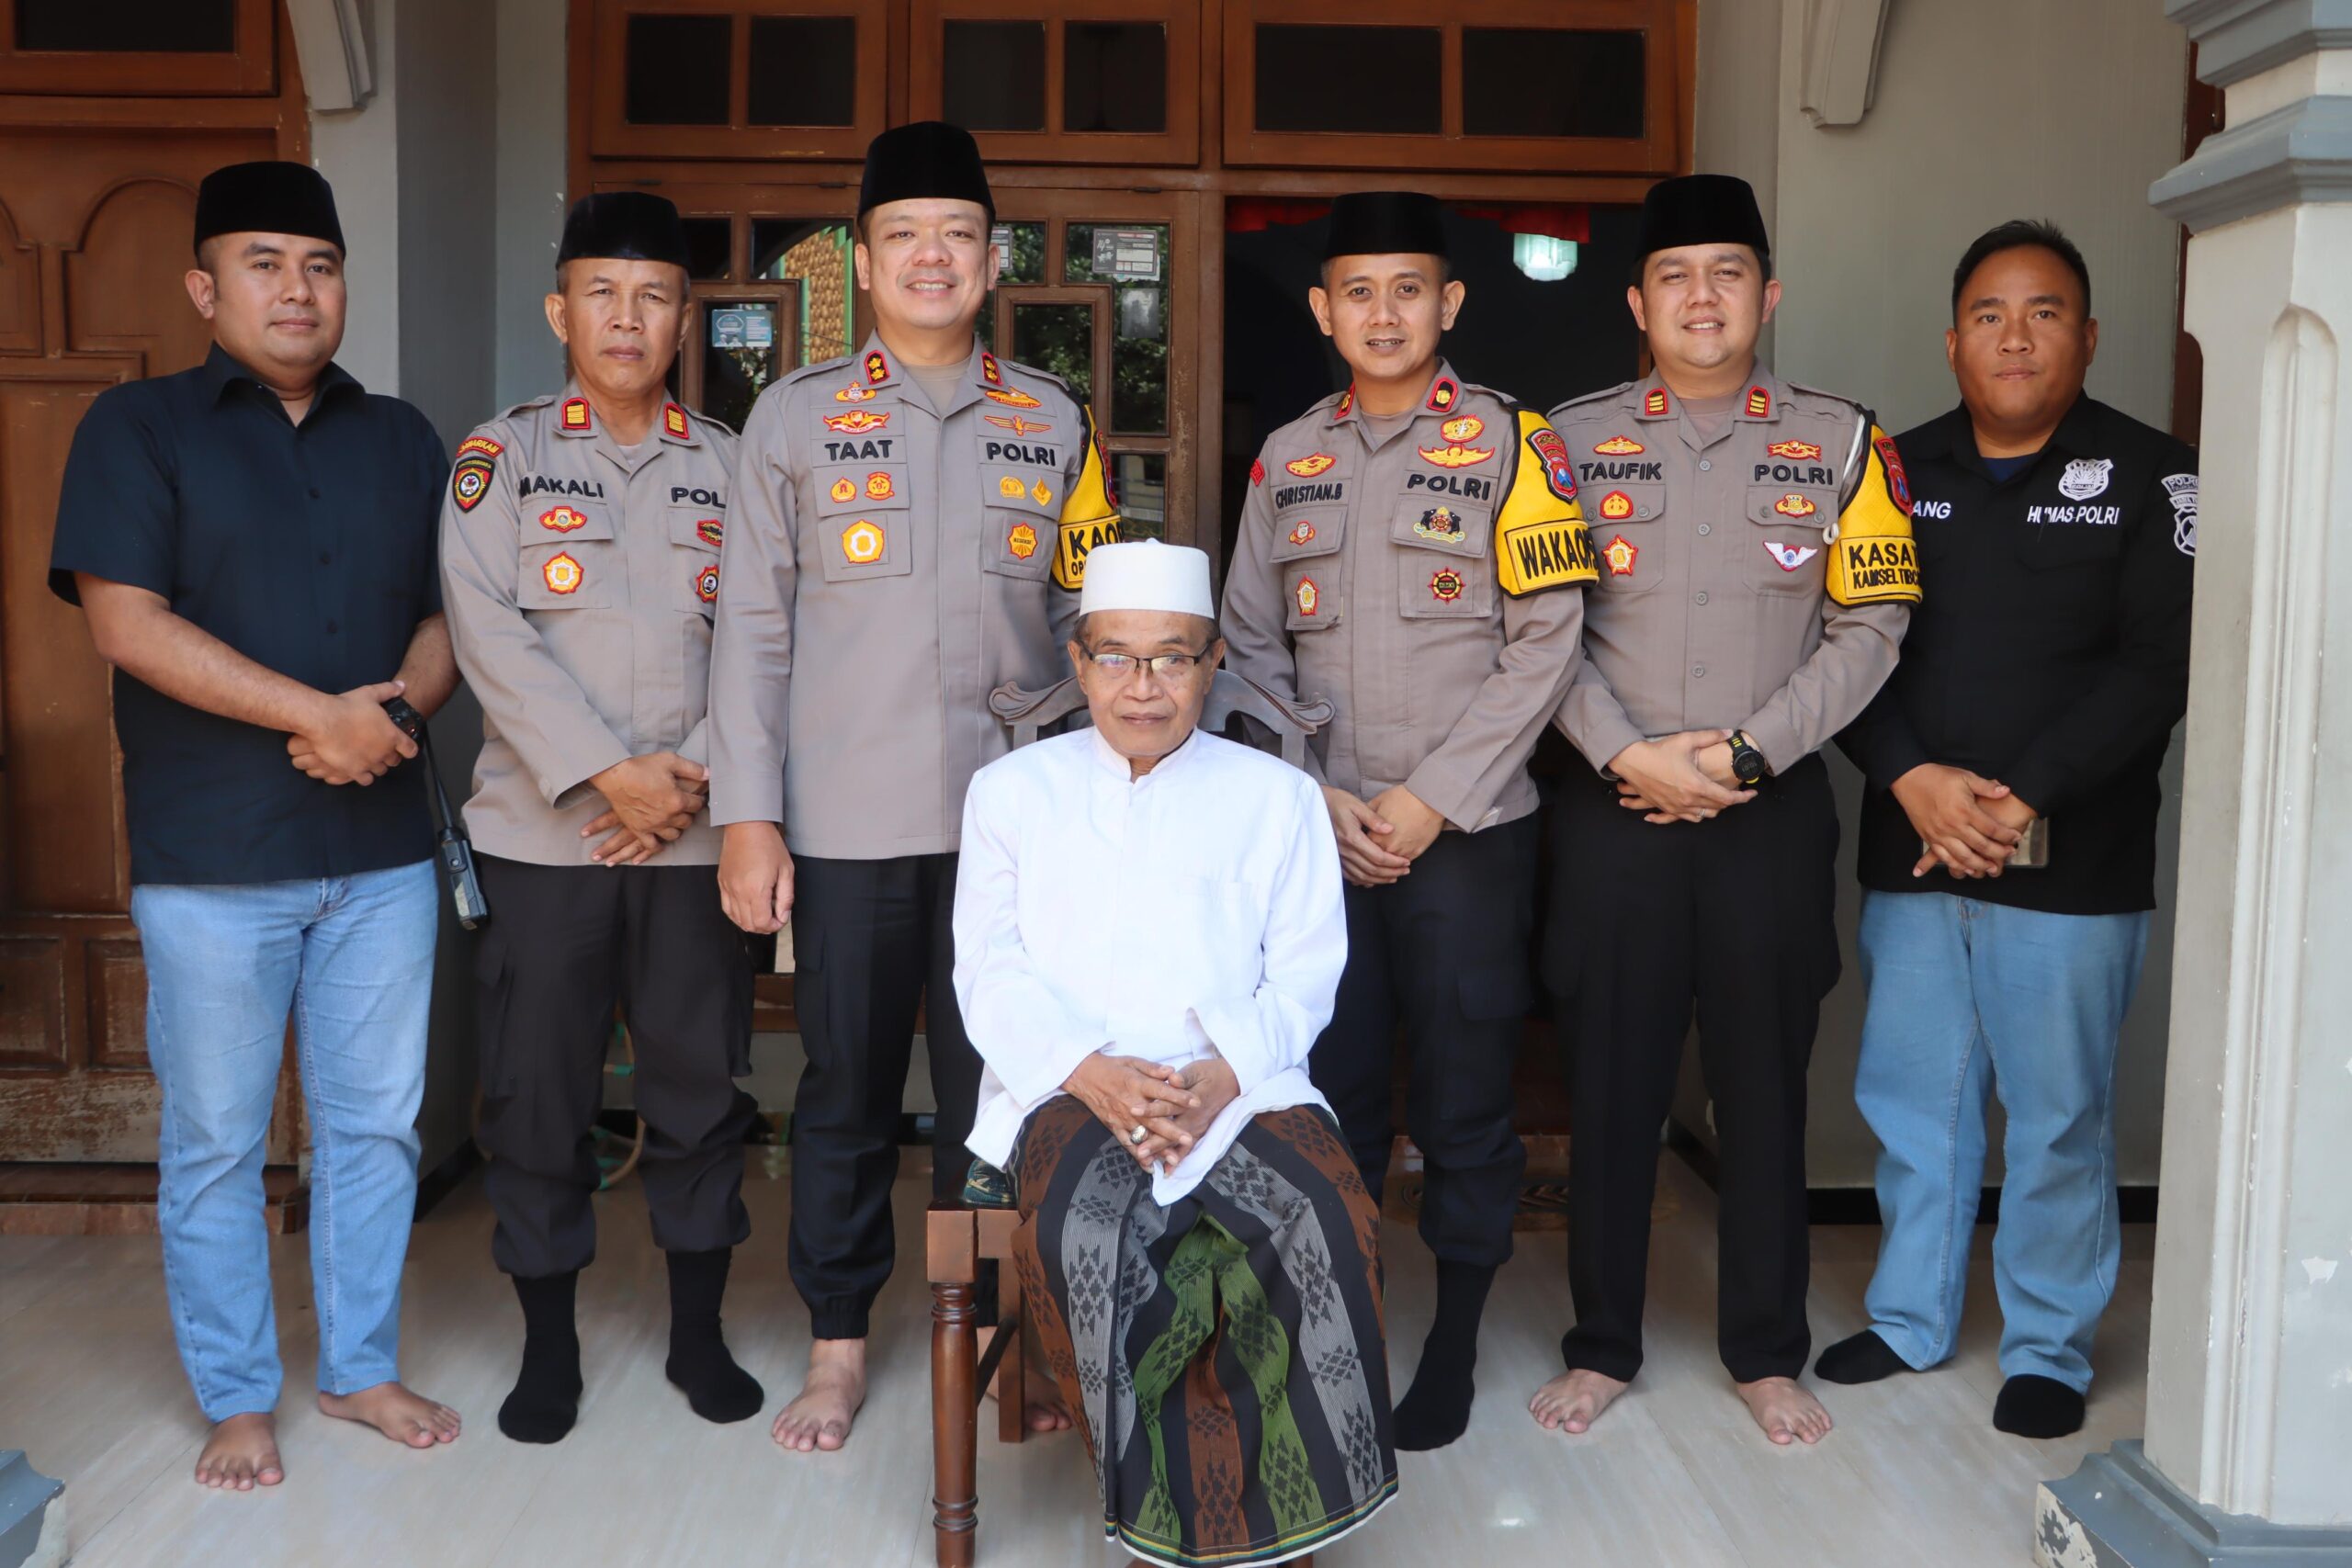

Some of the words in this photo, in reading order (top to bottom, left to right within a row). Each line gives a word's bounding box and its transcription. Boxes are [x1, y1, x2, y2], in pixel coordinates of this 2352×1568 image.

[824, 439, 893, 461] TAAT
[986, 442, 1056, 467] POLRI
[1578, 461, 1662, 482] TAUFIK
[1755, 464, 1833, 485] POLRI
[671, 486, 727, 509] POL
[1407, 473, 1491, 501] POLRI
[2075, 505, 2120, 525] POLRI
